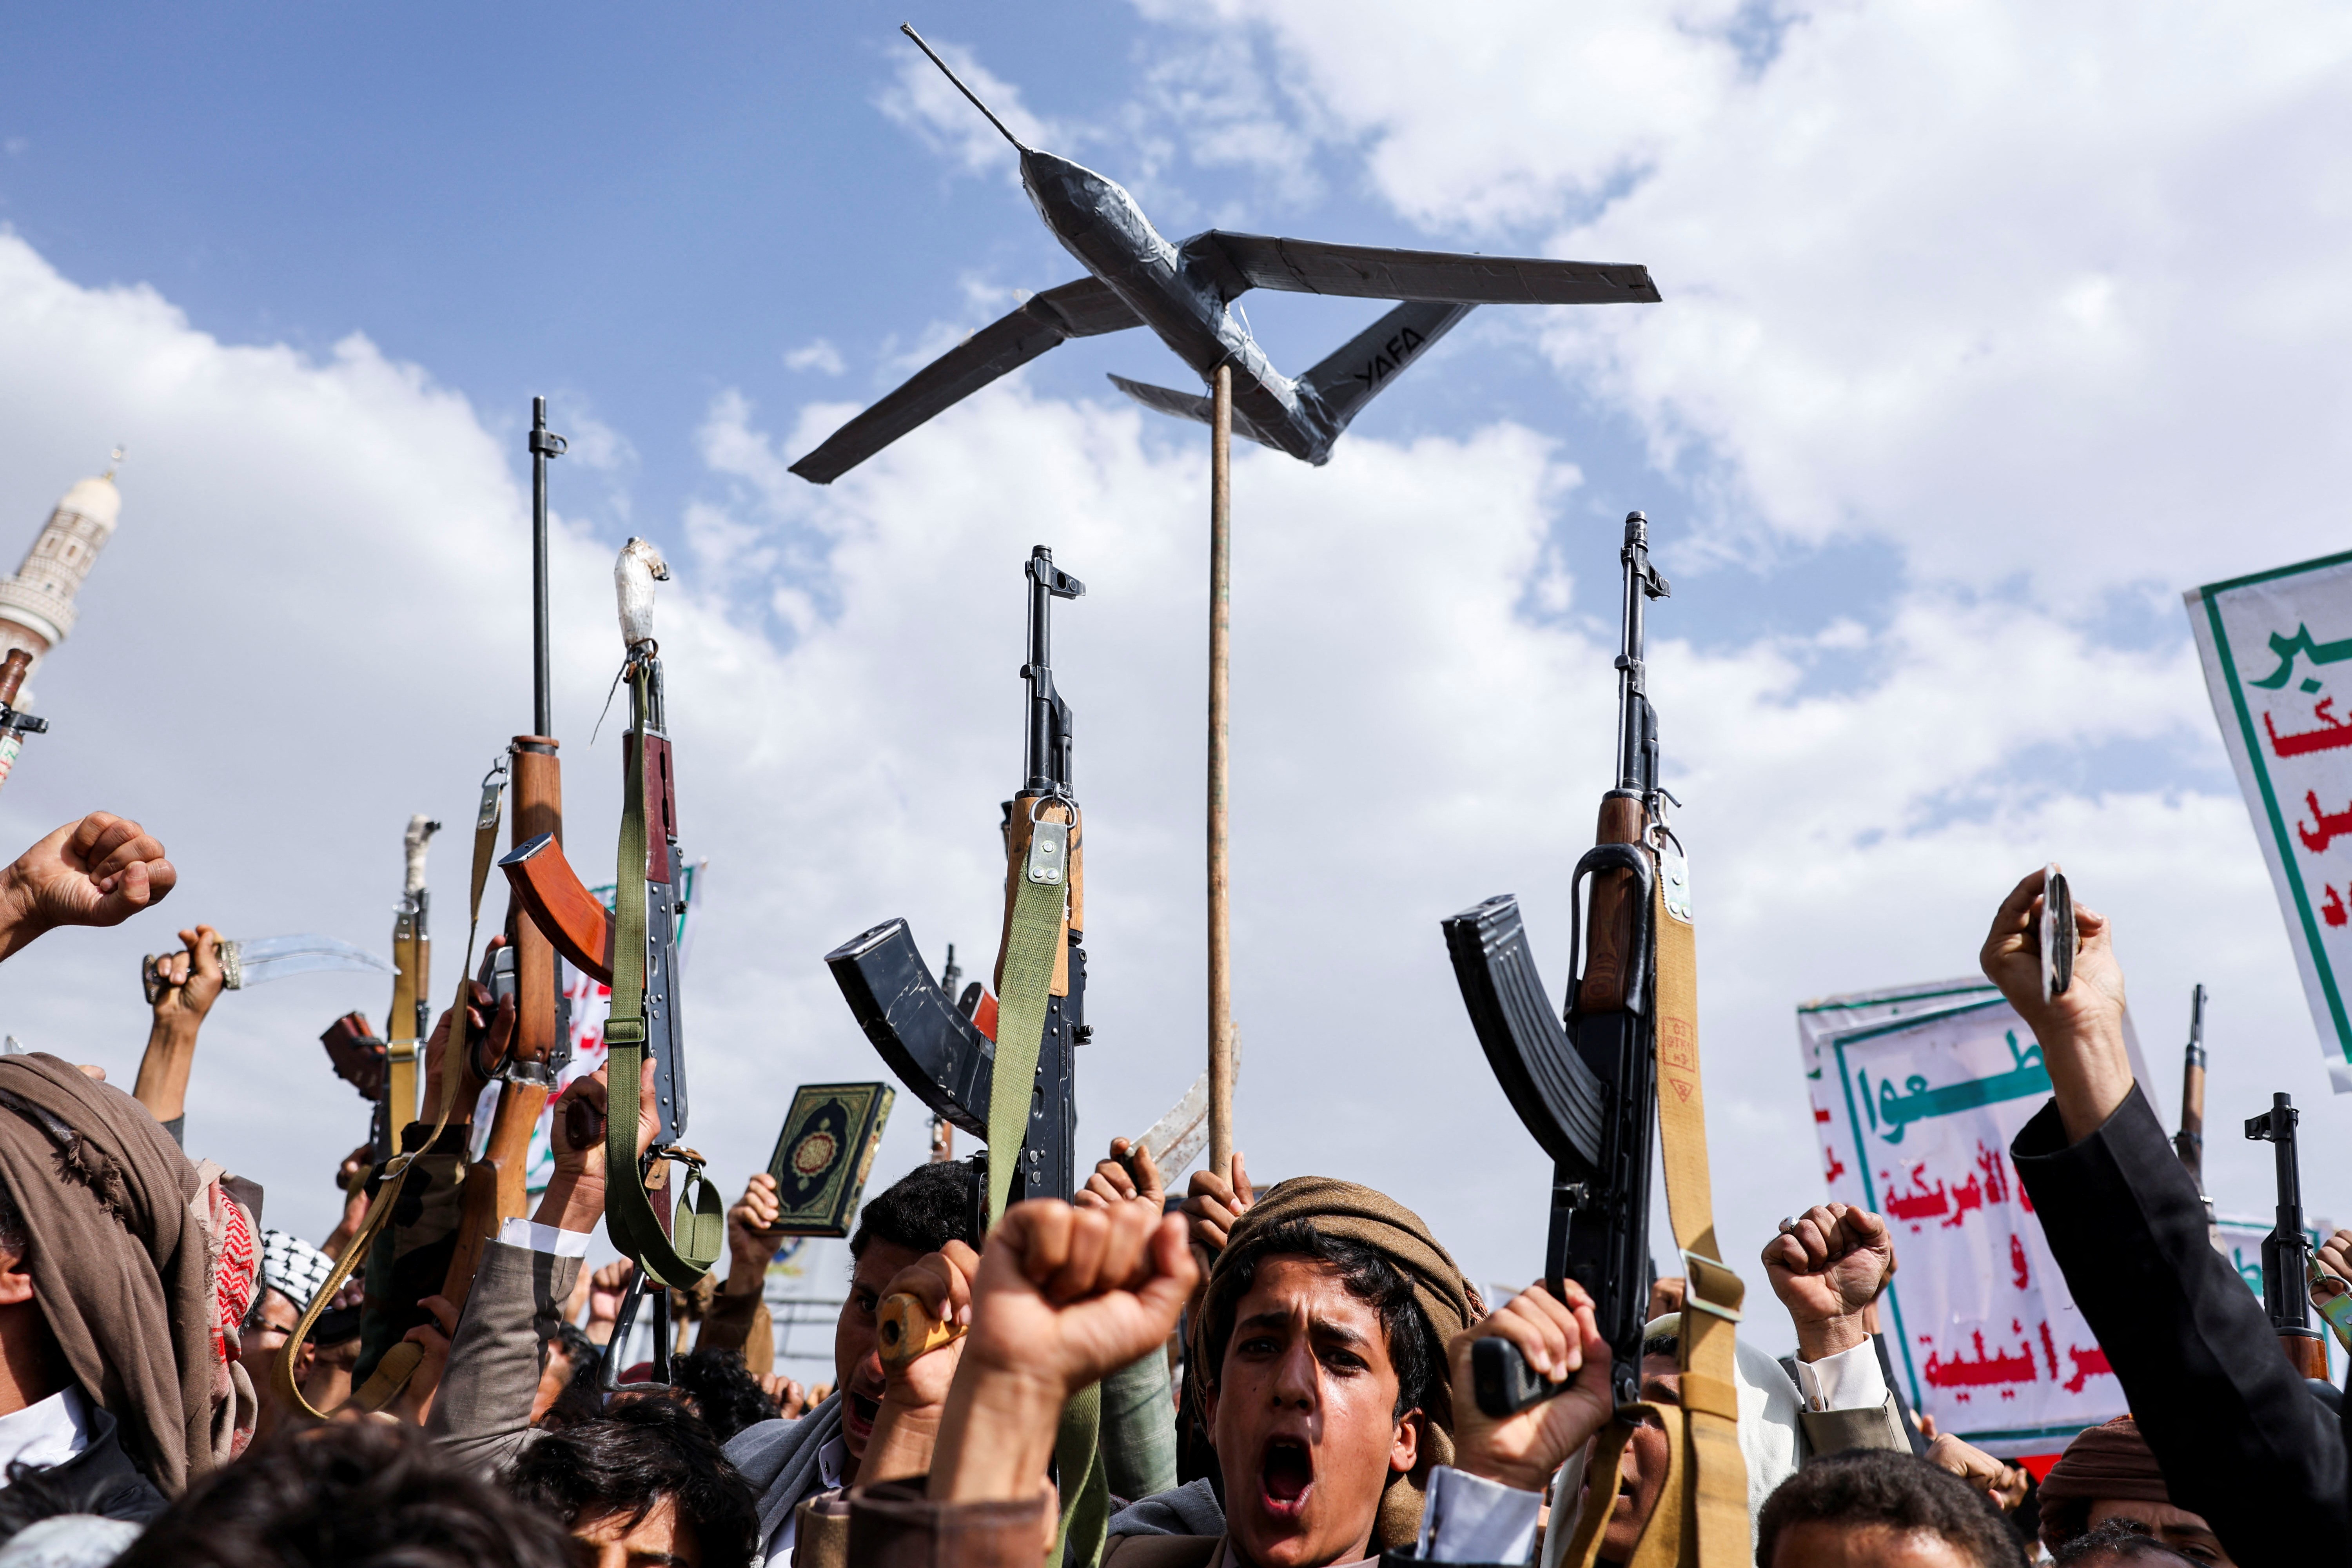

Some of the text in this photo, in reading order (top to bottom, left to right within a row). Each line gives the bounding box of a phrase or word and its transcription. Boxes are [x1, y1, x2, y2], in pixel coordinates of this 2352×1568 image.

[1354, 327, 1425, 391] YAFA
[2247, 621, 2352, 694] بر
[1858, 1028, 2053, 1145] طعوا
